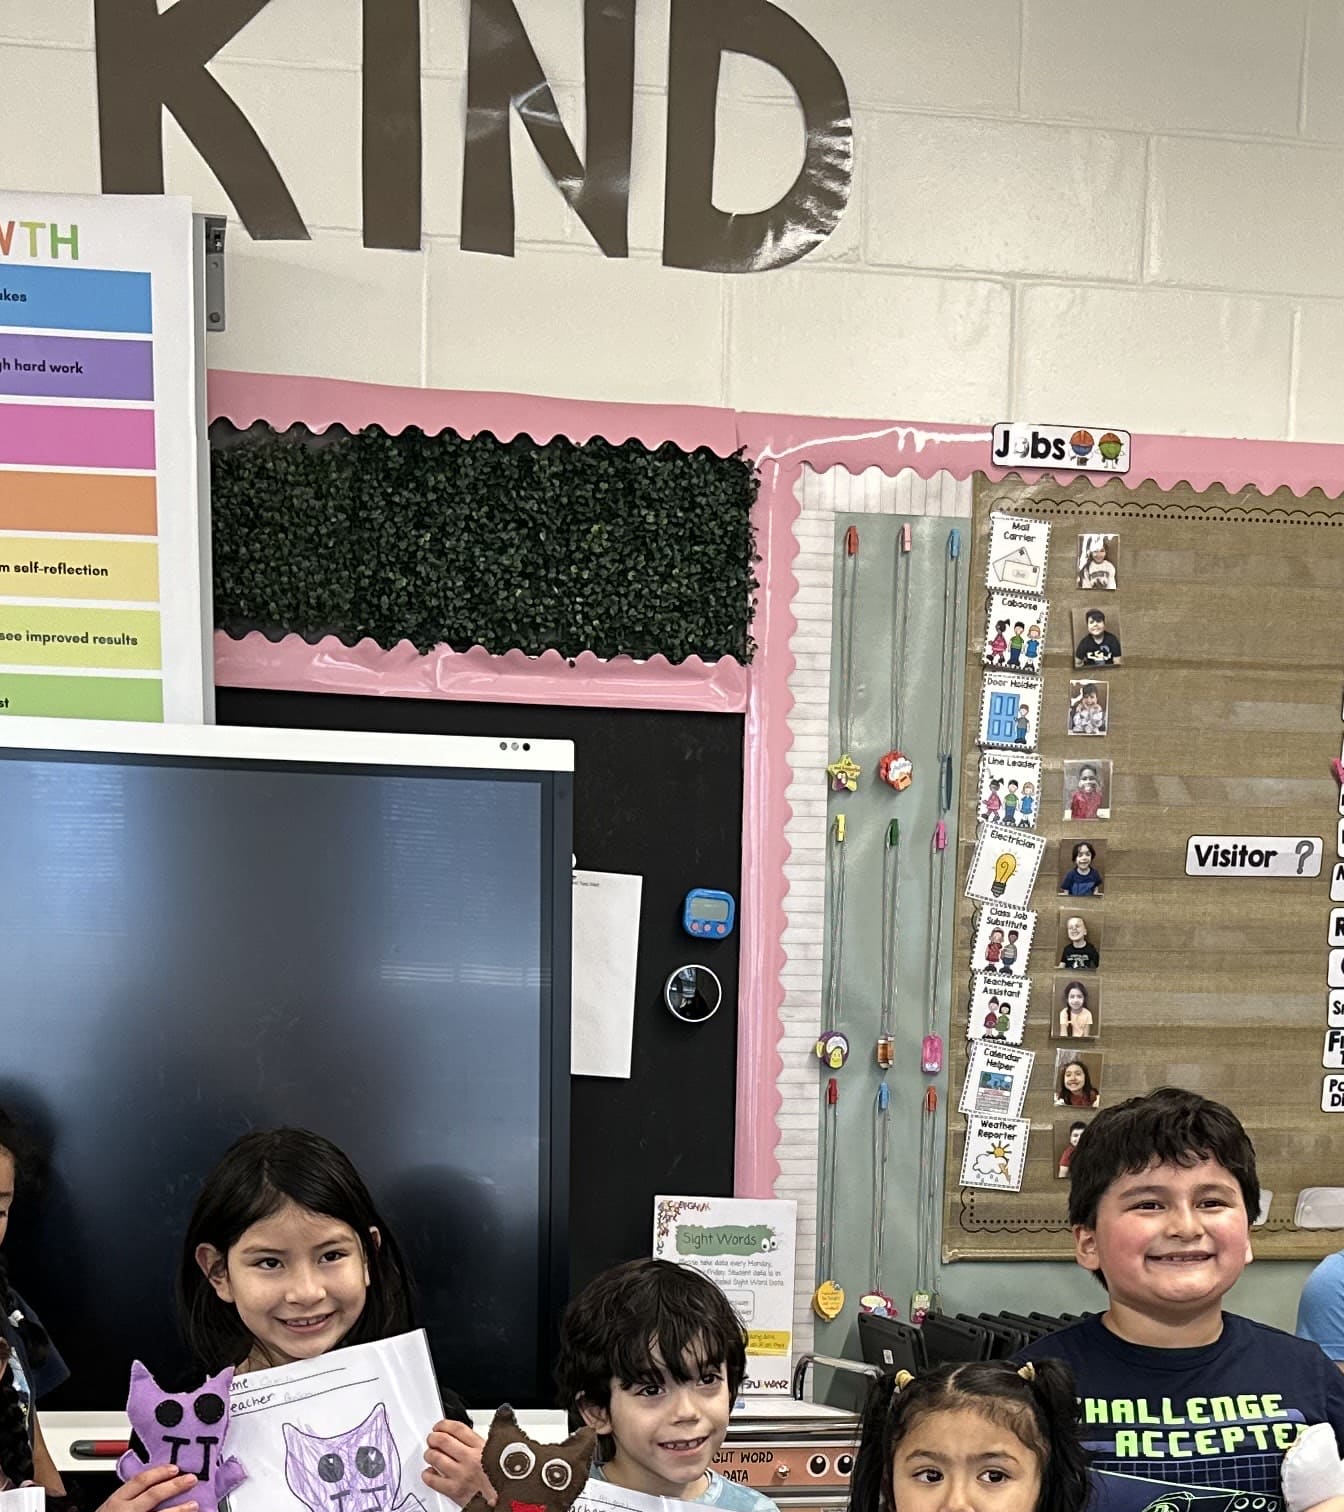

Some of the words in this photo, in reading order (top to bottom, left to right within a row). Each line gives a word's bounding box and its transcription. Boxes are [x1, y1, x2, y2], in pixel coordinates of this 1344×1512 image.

[96, 0, 853, 273] KIND
[14, 358, 46, 374] hard
[49, 361, 83, 375] work
[13, 560, 109, 578] self-reflection
[26, 629, 89, 646] improved
[92, 633, 138, 647] results
[1194, 844, 1278, 869] Visitor
[683, 1232, 713, 1249] Sight
[717, 1233, 757, 1246] Words
[1076, 1394, 1288, 1425] HALLENGE
[741, 1451, 774, 1464] WORD
[723, 1469, 749, 1483] DATA
